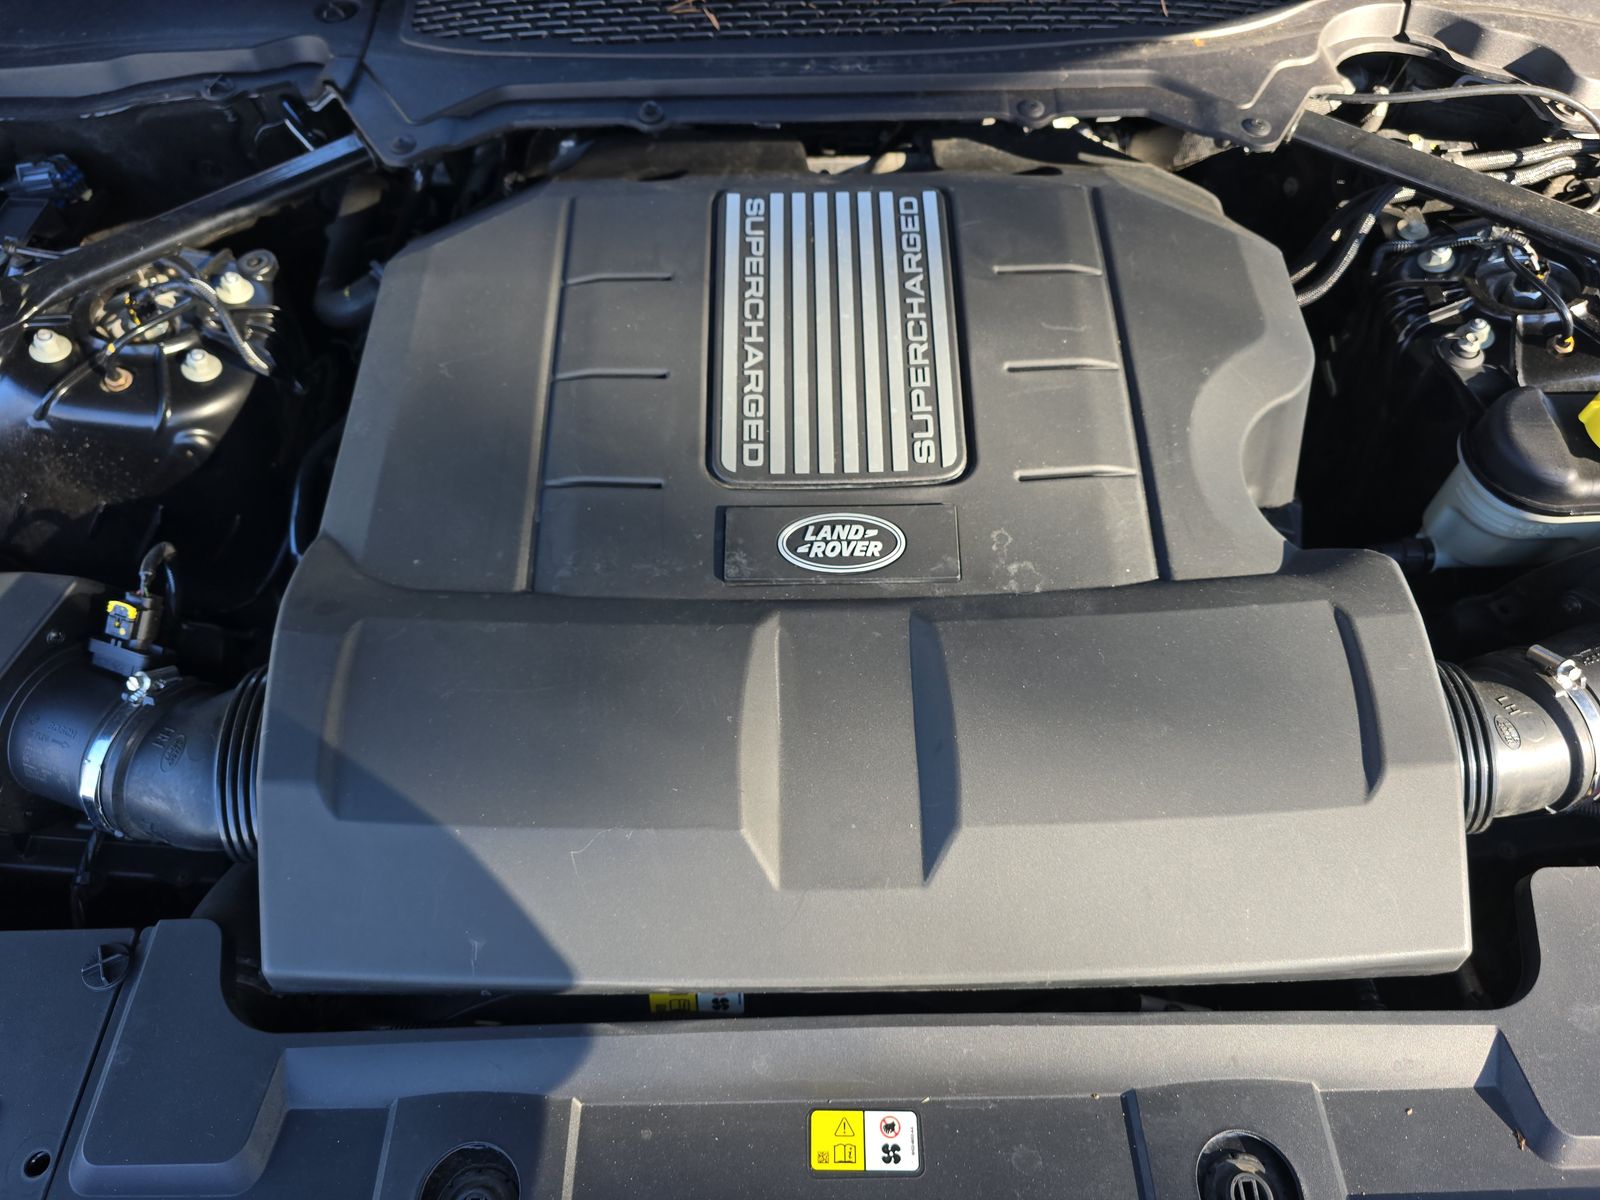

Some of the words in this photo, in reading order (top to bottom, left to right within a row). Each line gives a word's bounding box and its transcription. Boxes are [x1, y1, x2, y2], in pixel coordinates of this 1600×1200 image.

[742, 197, 765, 467] SUPERCHARGED
[898, 196, 936, 464] SUPERCHARGED
[804, 524, 865, 541] LAND
[809, 541, 883, 558] ROVER
[1494, 695, 1521, 716] LH
